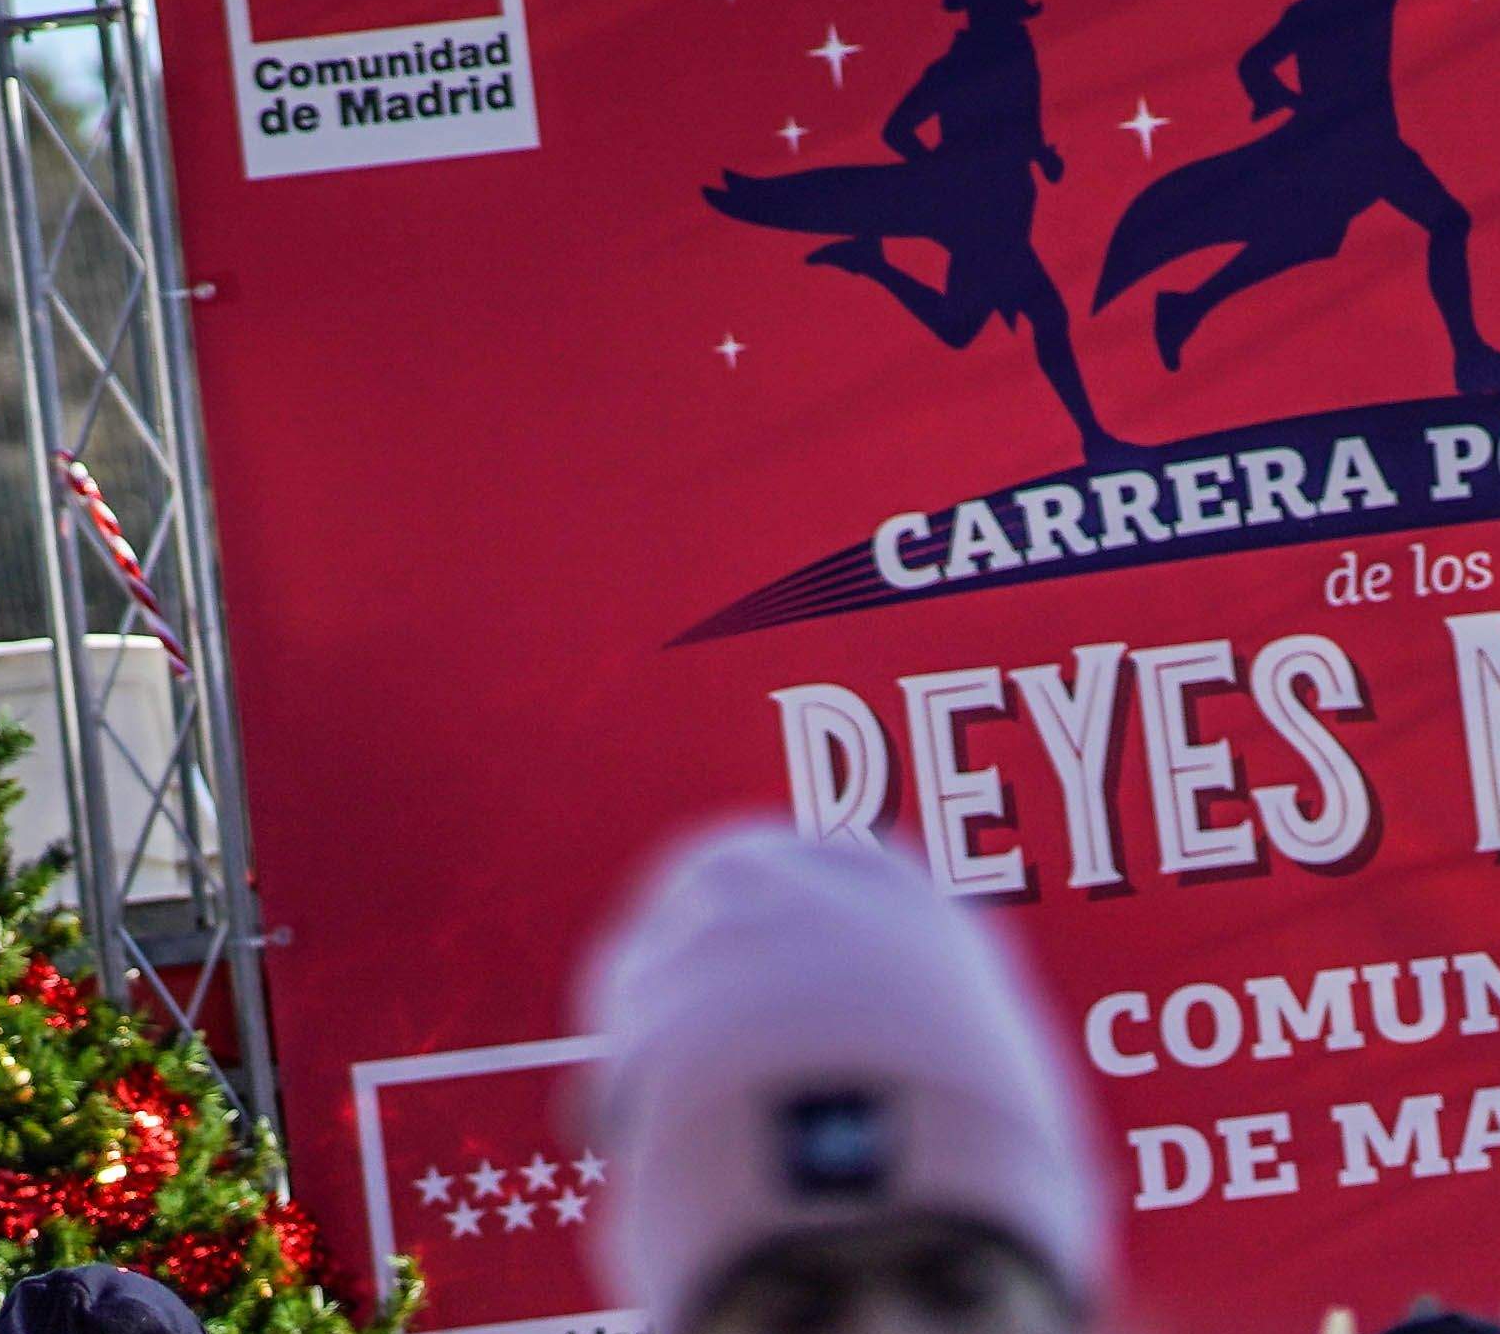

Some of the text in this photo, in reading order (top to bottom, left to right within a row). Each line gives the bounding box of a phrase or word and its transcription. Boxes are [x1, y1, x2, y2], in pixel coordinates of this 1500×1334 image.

[253, 32, 511, 91] Comunidad
[259, 71, 515, 136] de Madrid
[872, 436, 1398, 591] CARRERA
[1324, 542, 1494, 607] de los
[770, 632, 1372, 897] REYES
[1127, 1111, 1300, 1212] DE
